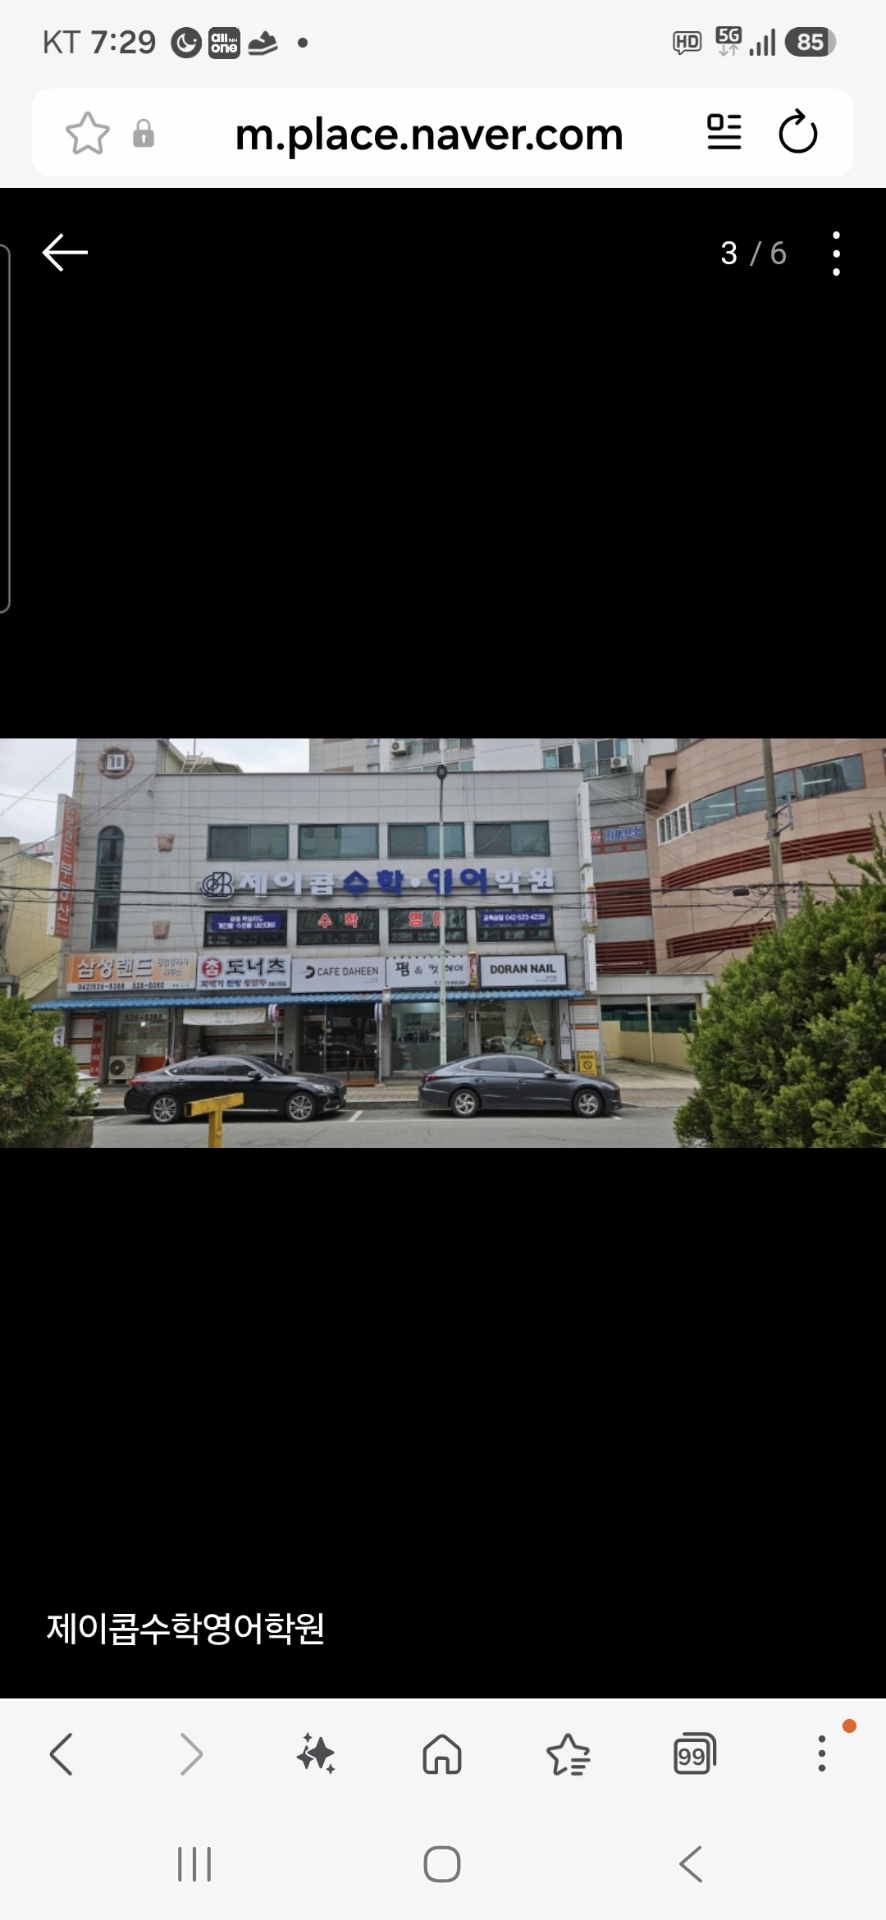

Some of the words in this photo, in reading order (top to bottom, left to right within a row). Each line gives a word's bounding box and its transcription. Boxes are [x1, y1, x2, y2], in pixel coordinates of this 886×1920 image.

[43, 30, 81, 54] KT
[91, 30, 155, 54] 7:29
[211, 33, 227, 42] all
[677, 35, 698, 48] HD
[719, 29, 739, 42] 5G
[797, 33, 824, 51] 85
[211, 43, 237, 53] one
[236, 116, 623, 159] m.place.naver.com
[722, 241, 737, 265] 3
[771, 241, 786, 265] 6
[78, 958, 152, 979] 삼성랜드
[225, 957, 287, 977] 도너츠
[317, 967, 340, 977] CAFE
[342, 966, 379, 976] DAHEEN
[490, 964, 528, 975] DORAN
[530, 963, 557, 974] NAIL
[678, 1747, 705, 1766] 99
